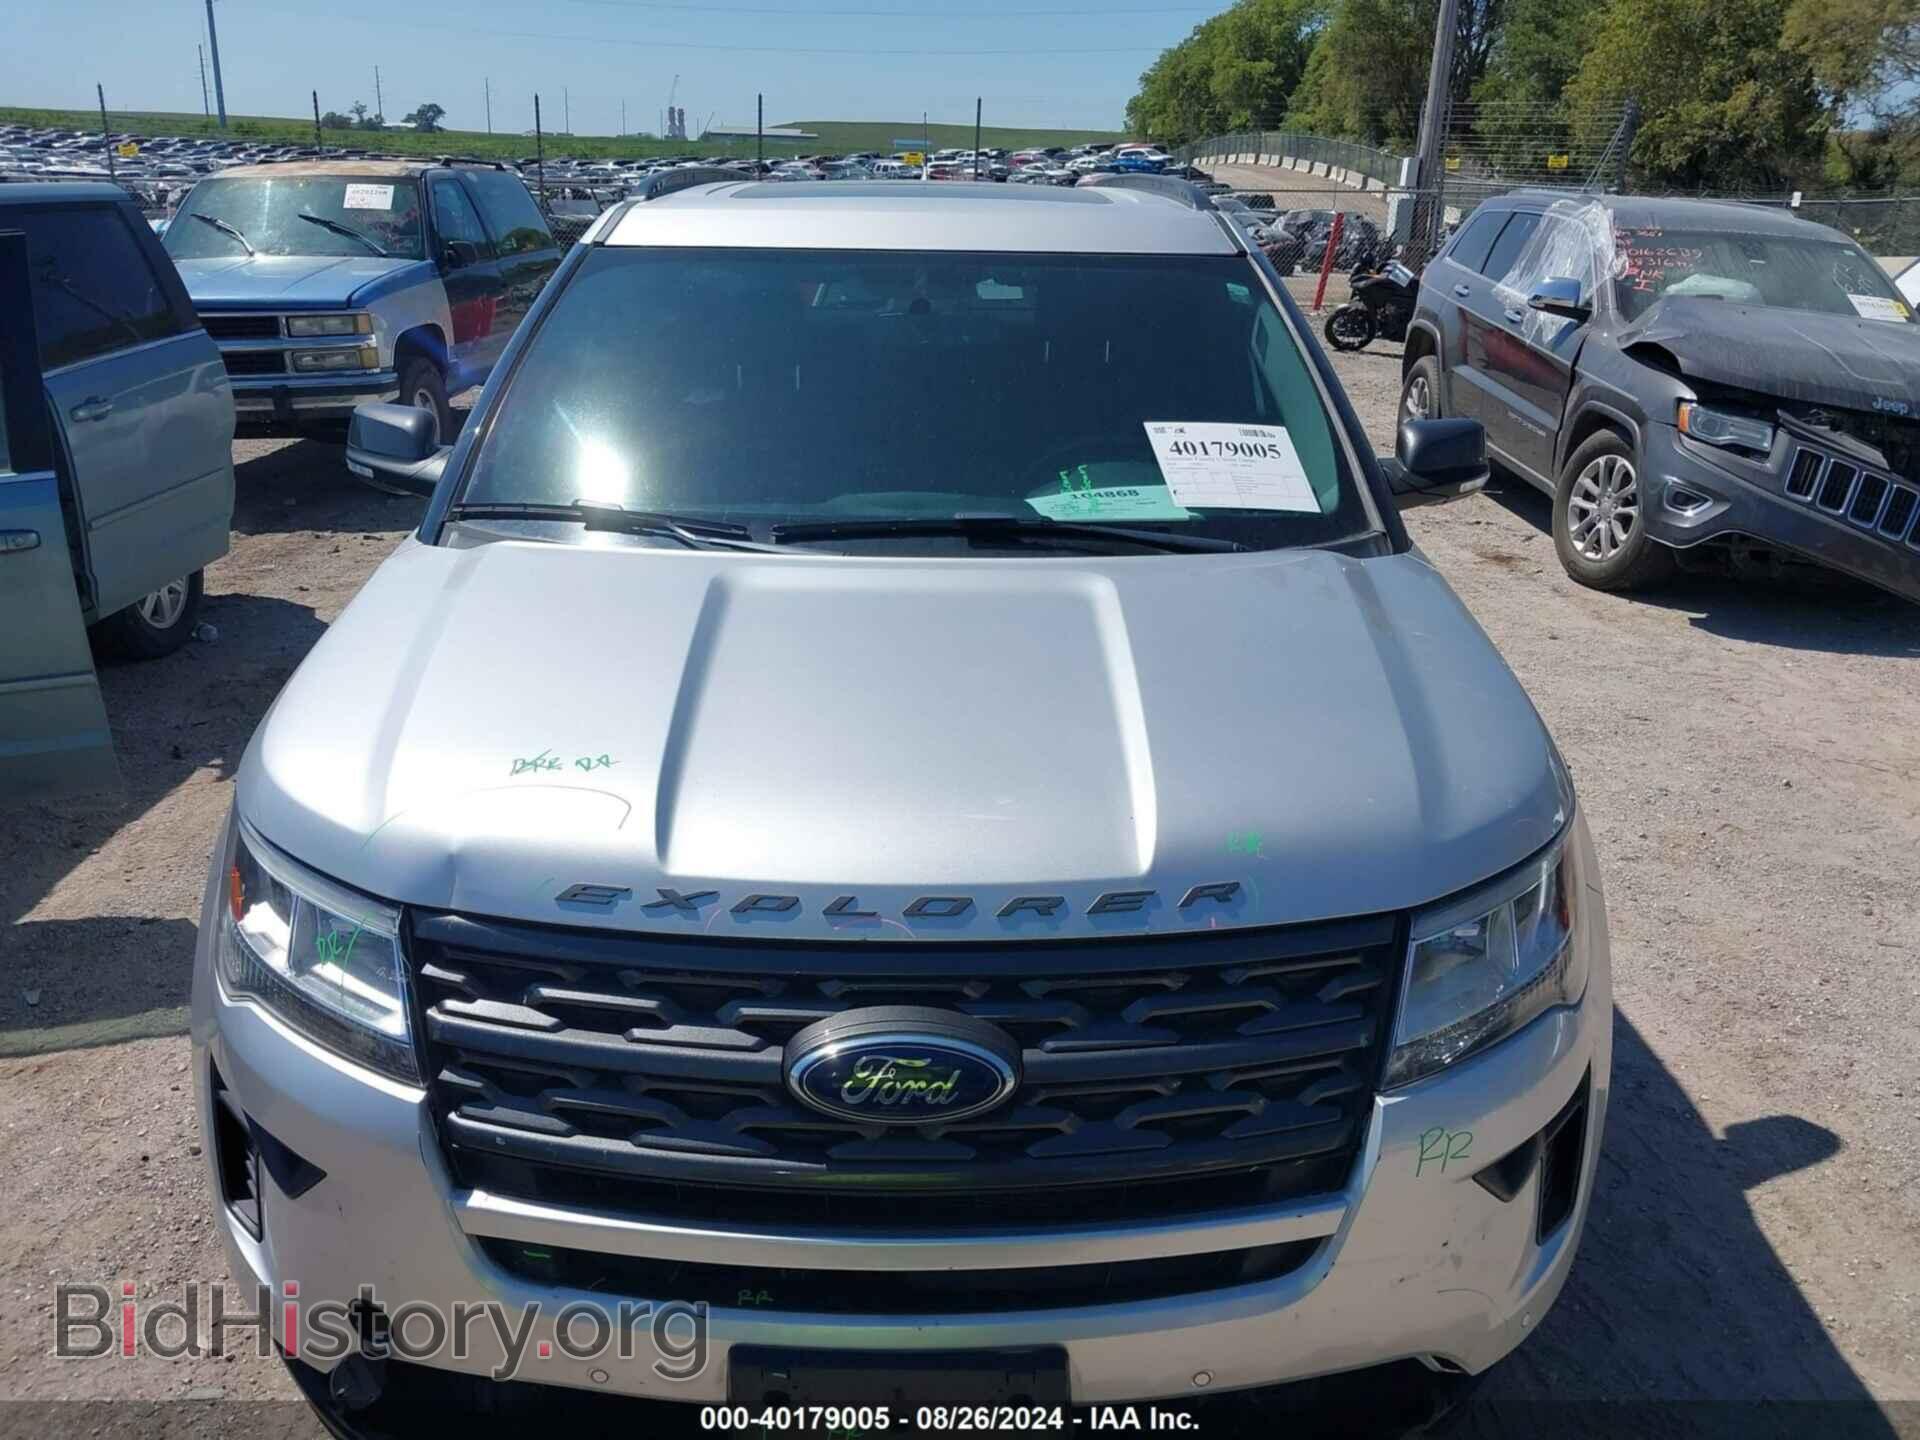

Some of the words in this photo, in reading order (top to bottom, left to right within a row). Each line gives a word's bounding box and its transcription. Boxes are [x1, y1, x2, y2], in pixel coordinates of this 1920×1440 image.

[1871, 397, 1908, 415] Jeep
[1168, 440, 1281, 459] 40179005
[554, 882, 1241, 916] EXPLORER
[840, 1054, 962, 1105] Ford
